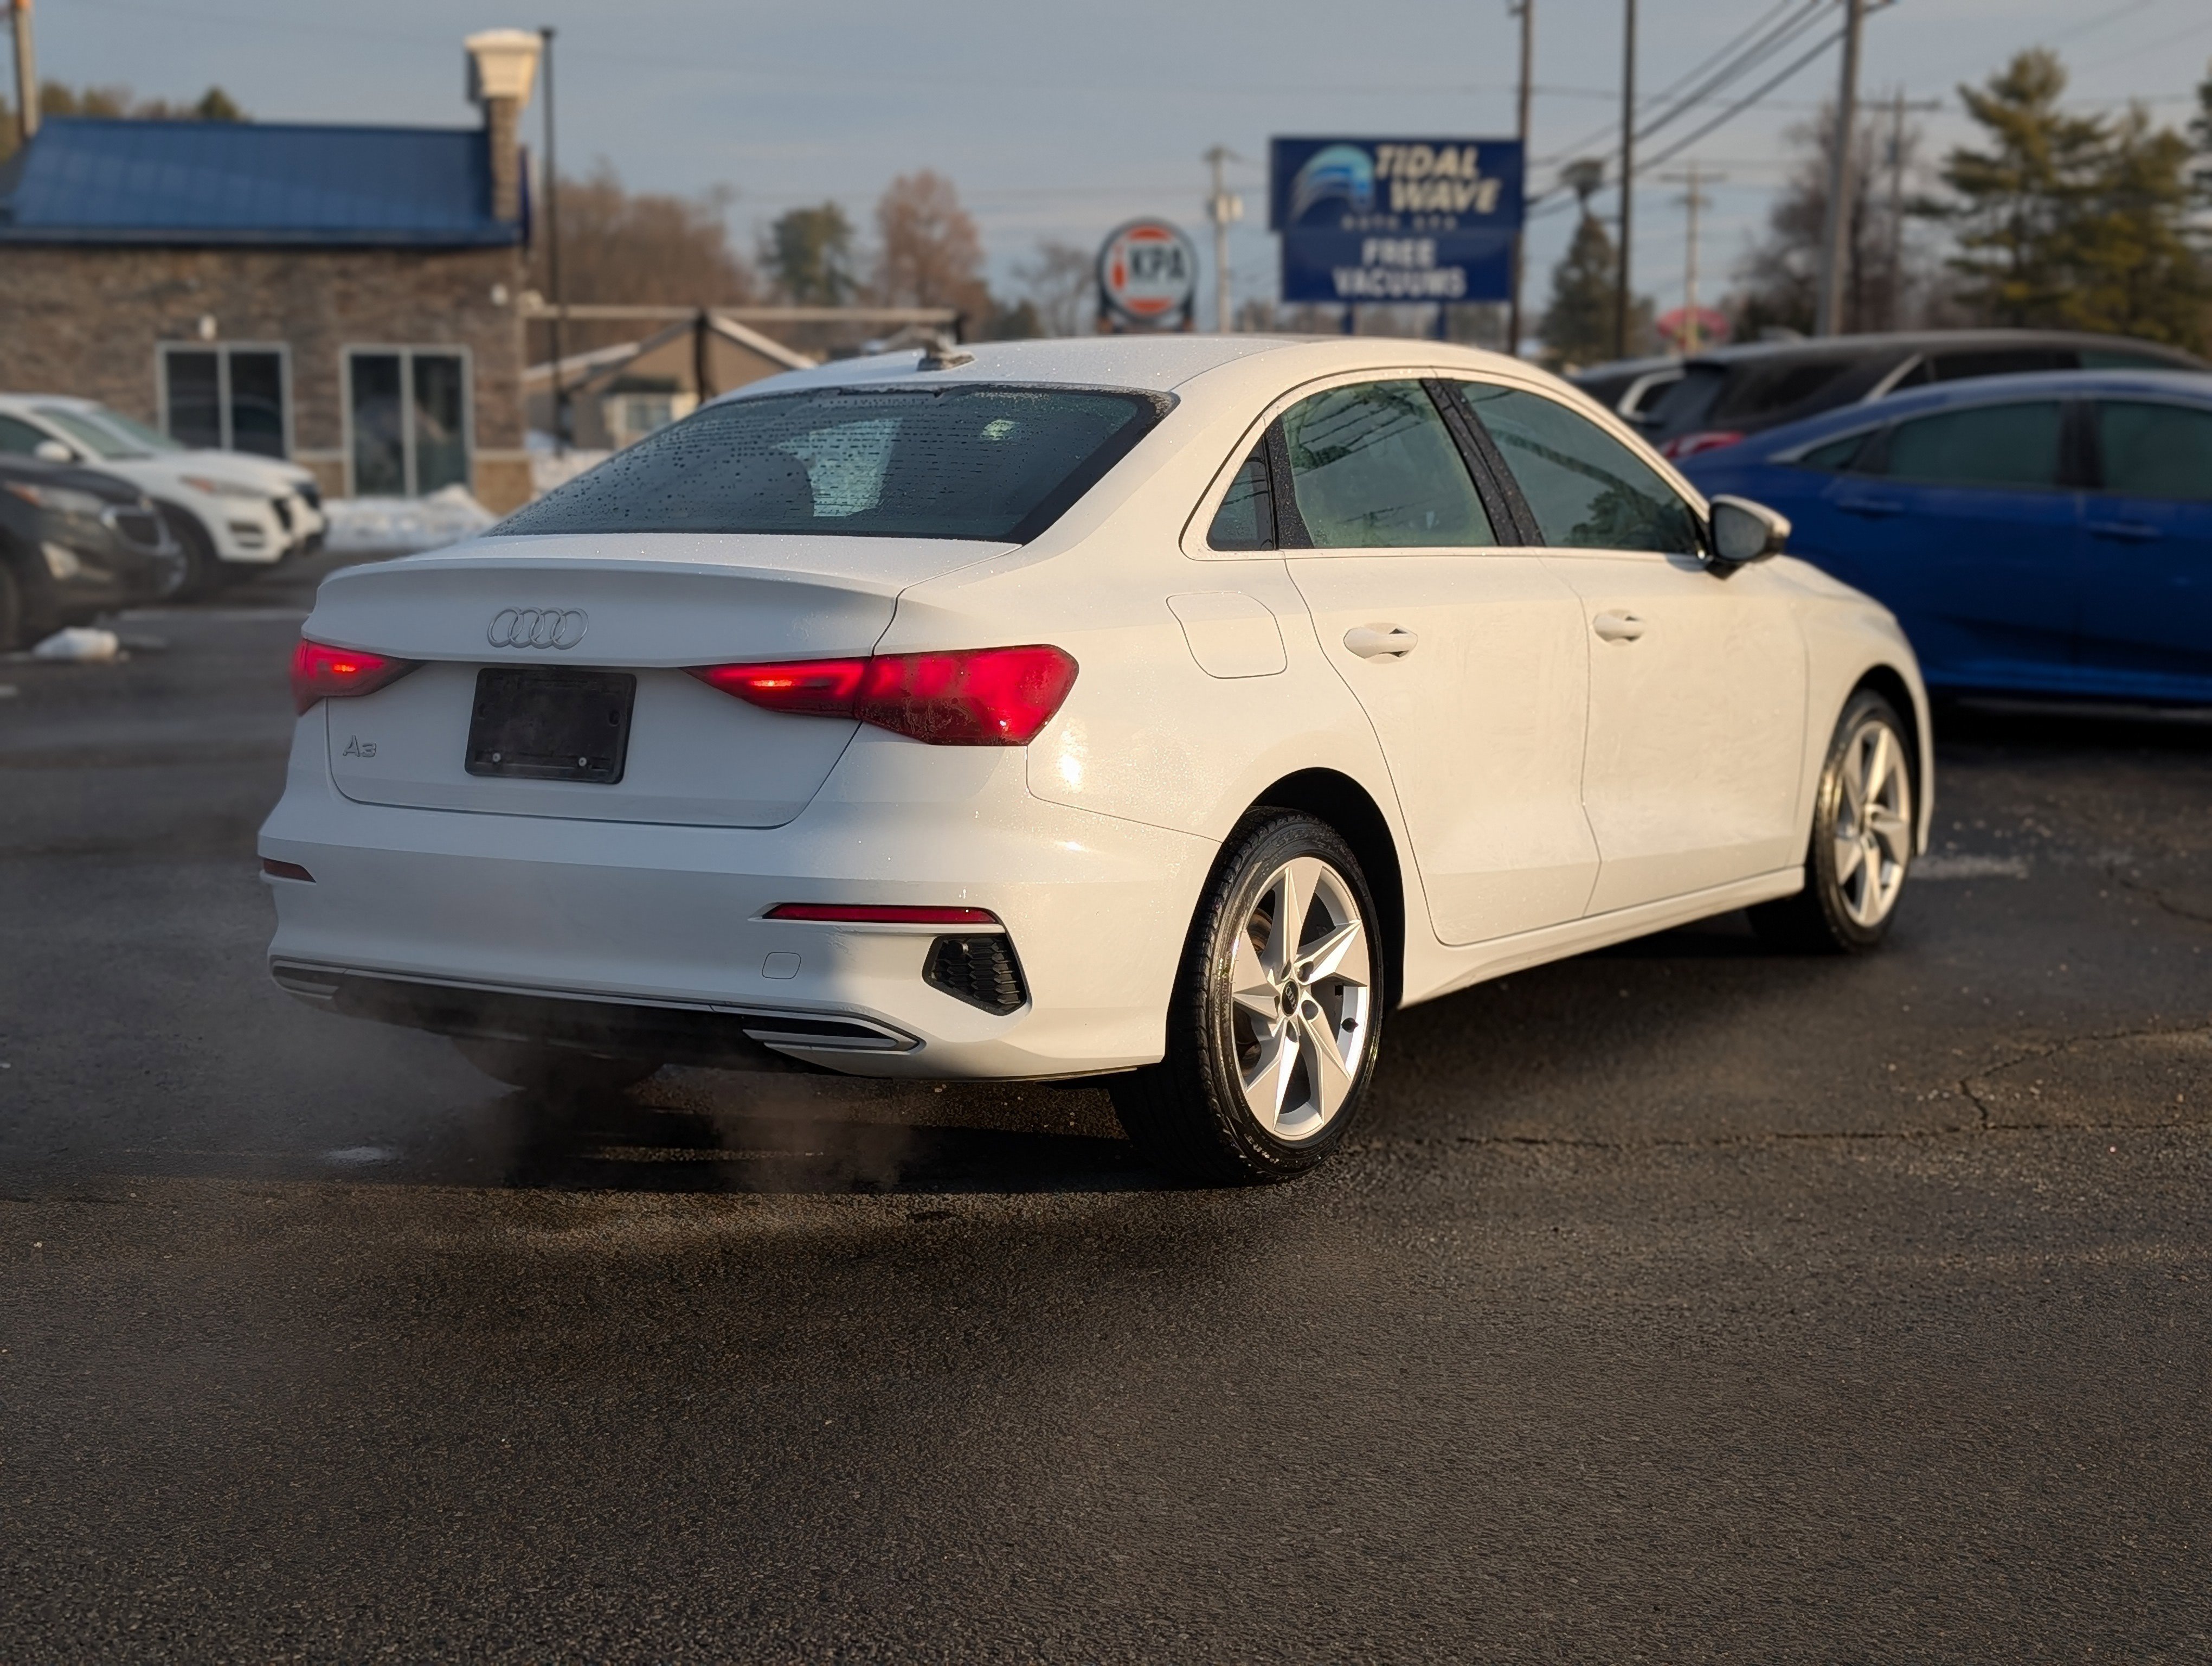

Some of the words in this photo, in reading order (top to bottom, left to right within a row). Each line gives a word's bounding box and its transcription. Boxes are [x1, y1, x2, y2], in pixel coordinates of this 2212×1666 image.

[1376, 145, 1480, 179] TIDAL
[1390, 179, 1501, 213] WAVE
[1362, 238, 1435, 267] FREE
[1332, 267, 1466, 297] VACUUMS
[343, 734, 376, 758] A3
